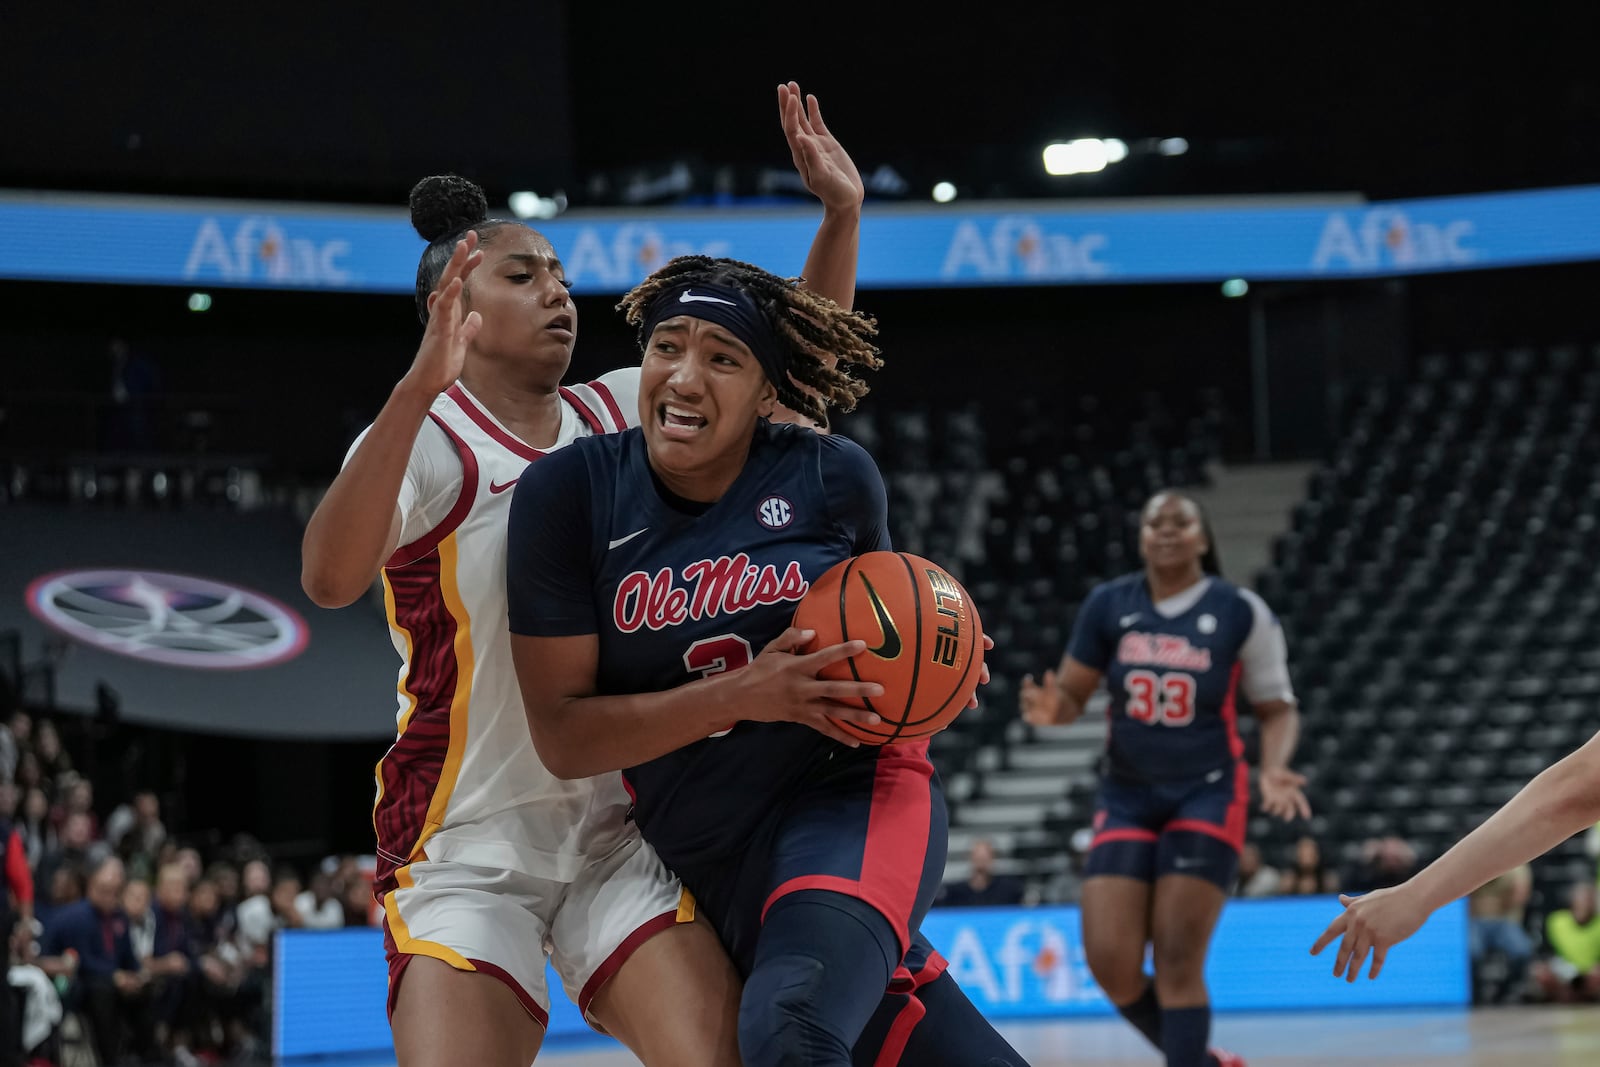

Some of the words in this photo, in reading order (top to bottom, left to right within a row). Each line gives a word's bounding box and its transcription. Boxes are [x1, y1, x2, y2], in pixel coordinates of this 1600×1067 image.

[183, 215, 351, 285] Aflac
[941, 214, 1109, 282] Aflac
[1312, 205, 1477, 274] Aflac
[760, 497, 791, 527] SEC
[613, 567, 688, 633] Ole
[682, 552, 809, 621] Miss
[924, 568, 960, 669] ELITE
[1124, 669, 1196, 727] 33
